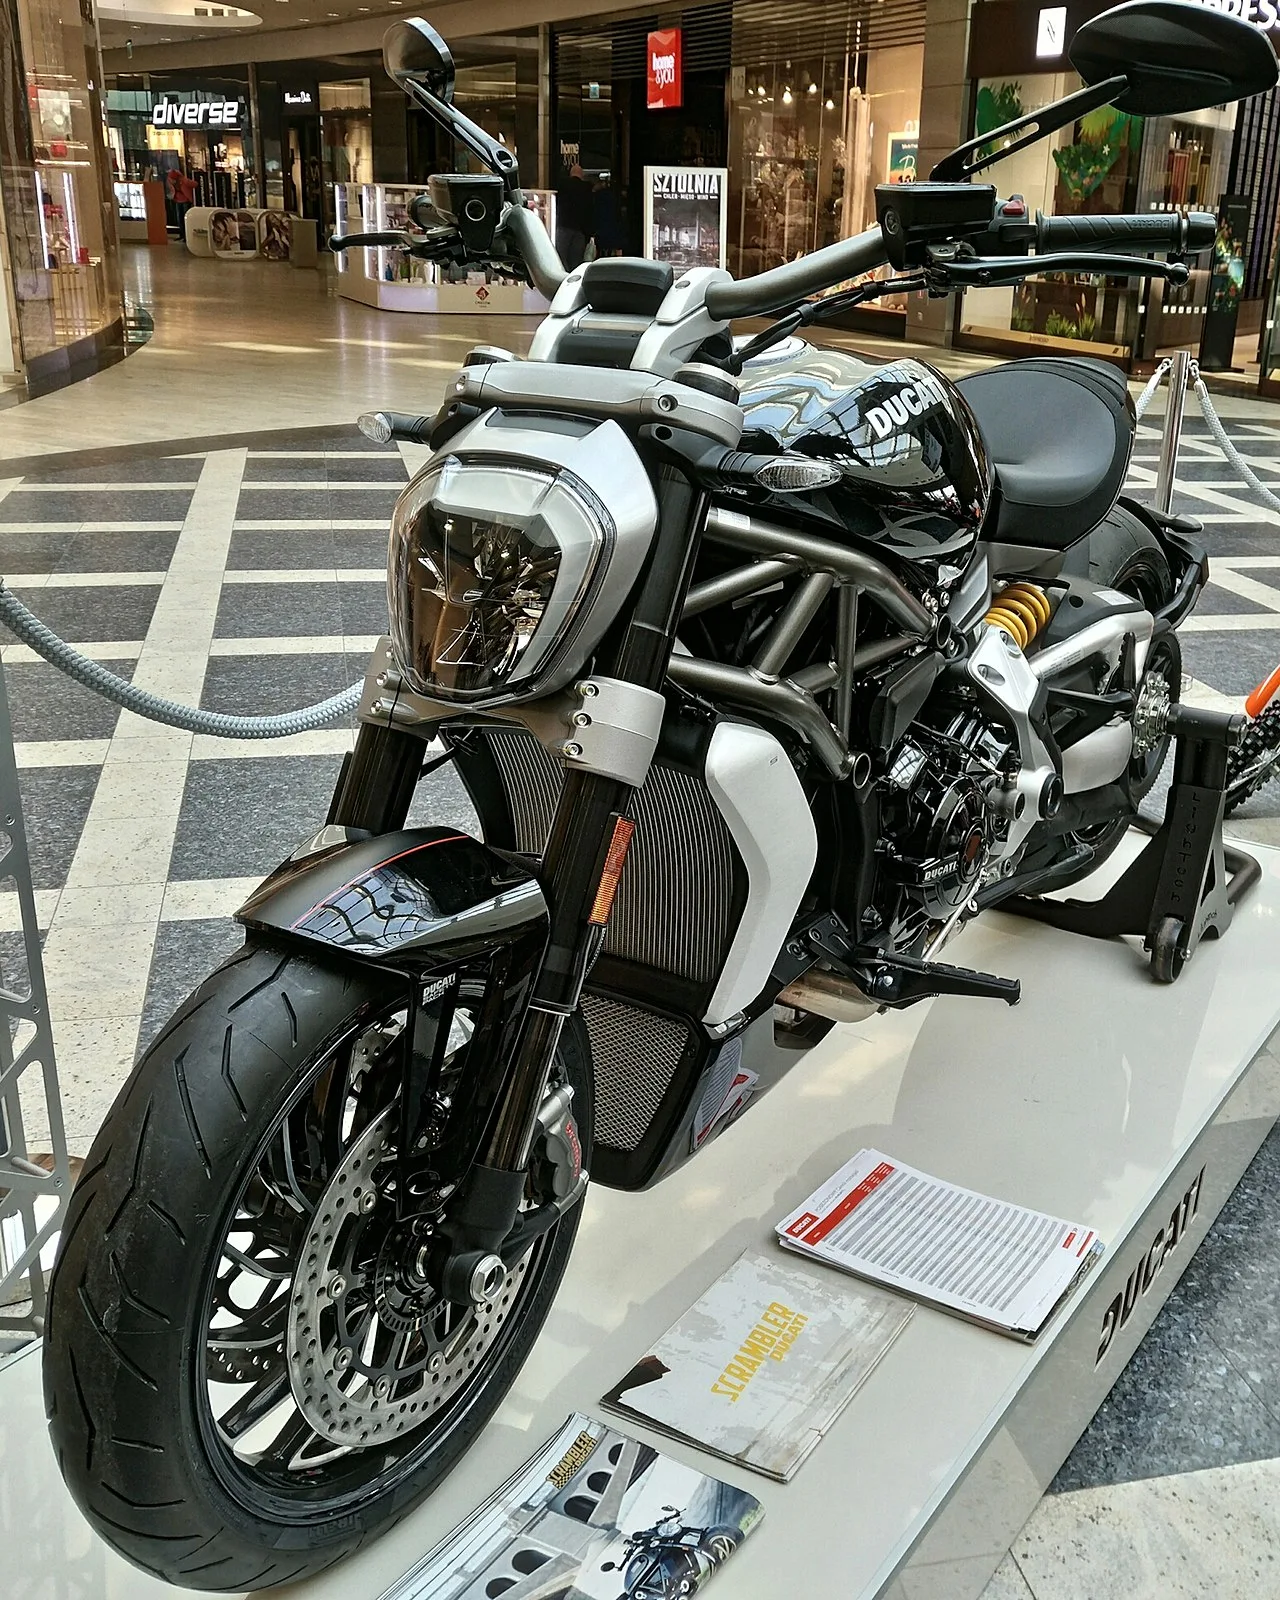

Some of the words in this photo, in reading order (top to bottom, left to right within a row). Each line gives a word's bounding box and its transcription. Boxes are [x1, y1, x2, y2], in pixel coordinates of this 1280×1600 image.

[653, 52, 675, 71] home
[153, 97, 239, 124] diverse
[560, 139, 580, 155] home
[654, 173, 719, 194] SZTOLNIA
[924, 861, 957, 881] DUCATI
[423, 972, 456, 997] DUCATI
[792, 1216, 812, 1235] DUCATI
[1094, 1162, 1207, 1371] DUCATI
[769, 1313, 809, 1362] DUCATI
[711, 1302, 796, 1402] SCRAMBLER
[546, 1431, 591, 1486] SCRAMBLER
[575, 1437, 597, 1467] DUCATI
